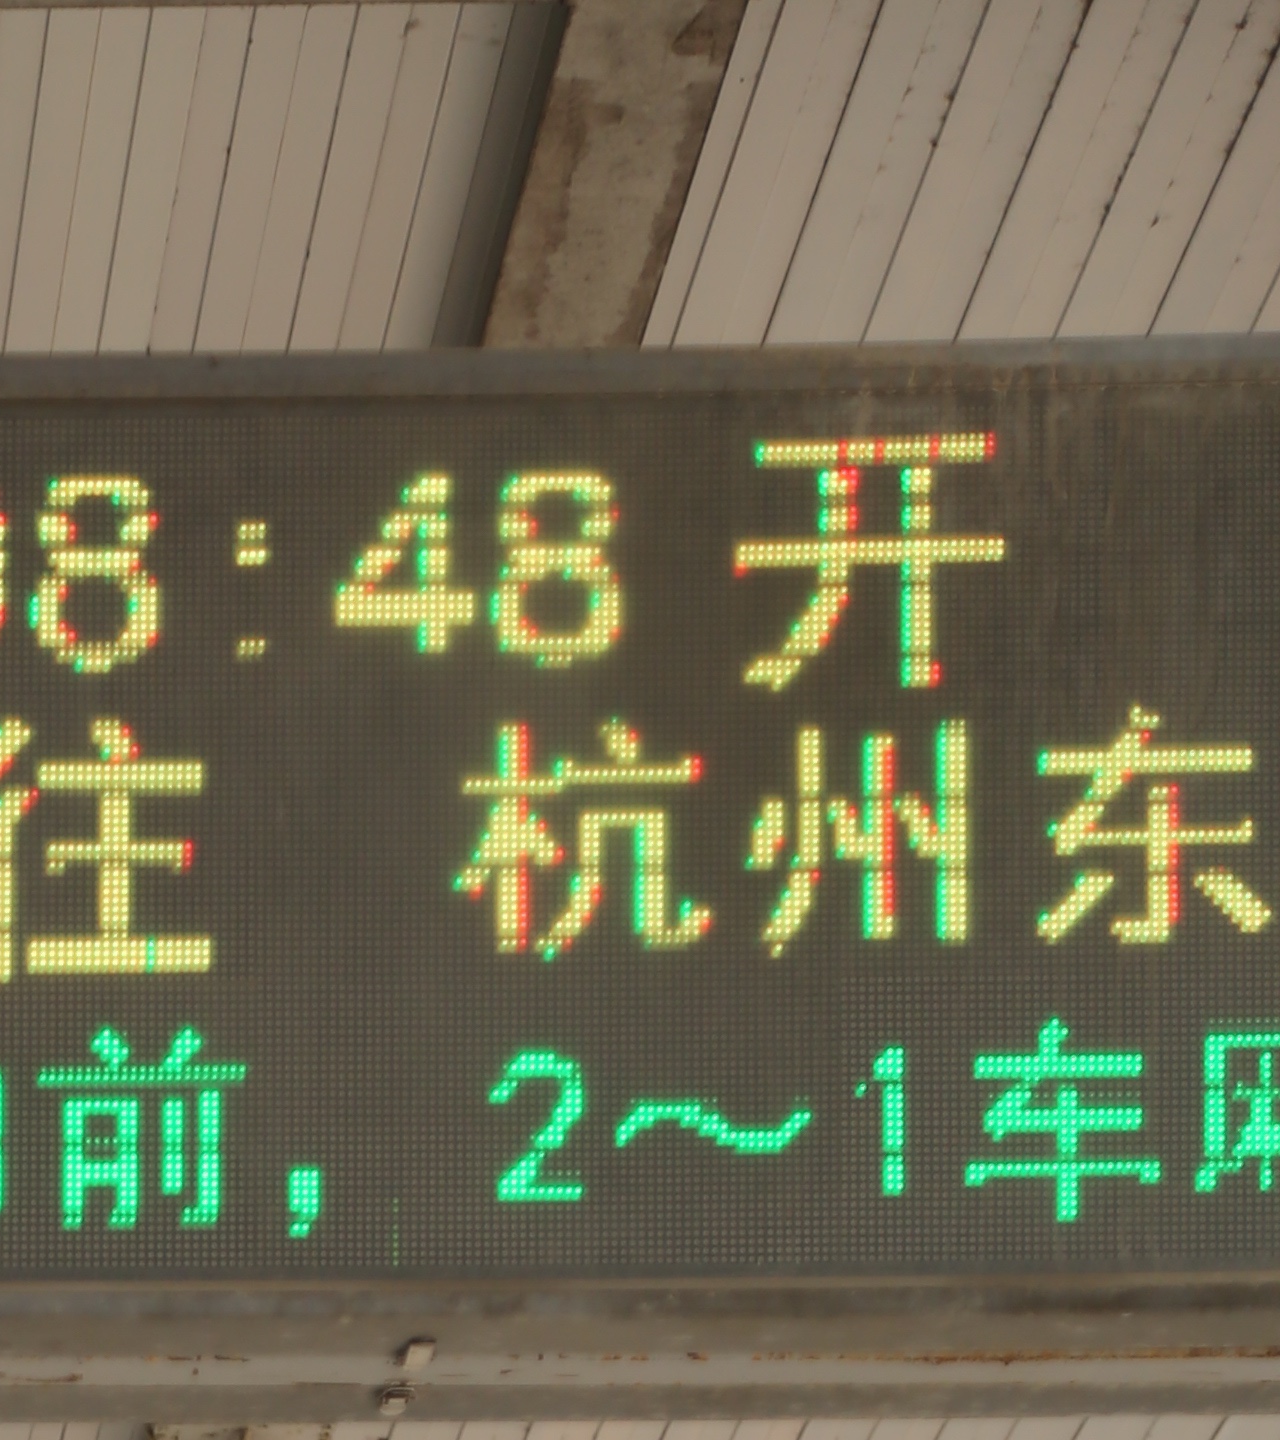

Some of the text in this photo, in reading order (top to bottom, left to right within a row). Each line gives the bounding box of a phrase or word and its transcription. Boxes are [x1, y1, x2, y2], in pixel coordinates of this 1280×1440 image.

[733, 431, 1007, 692] 开
[451, 704, 1273, 963] 杭州东
